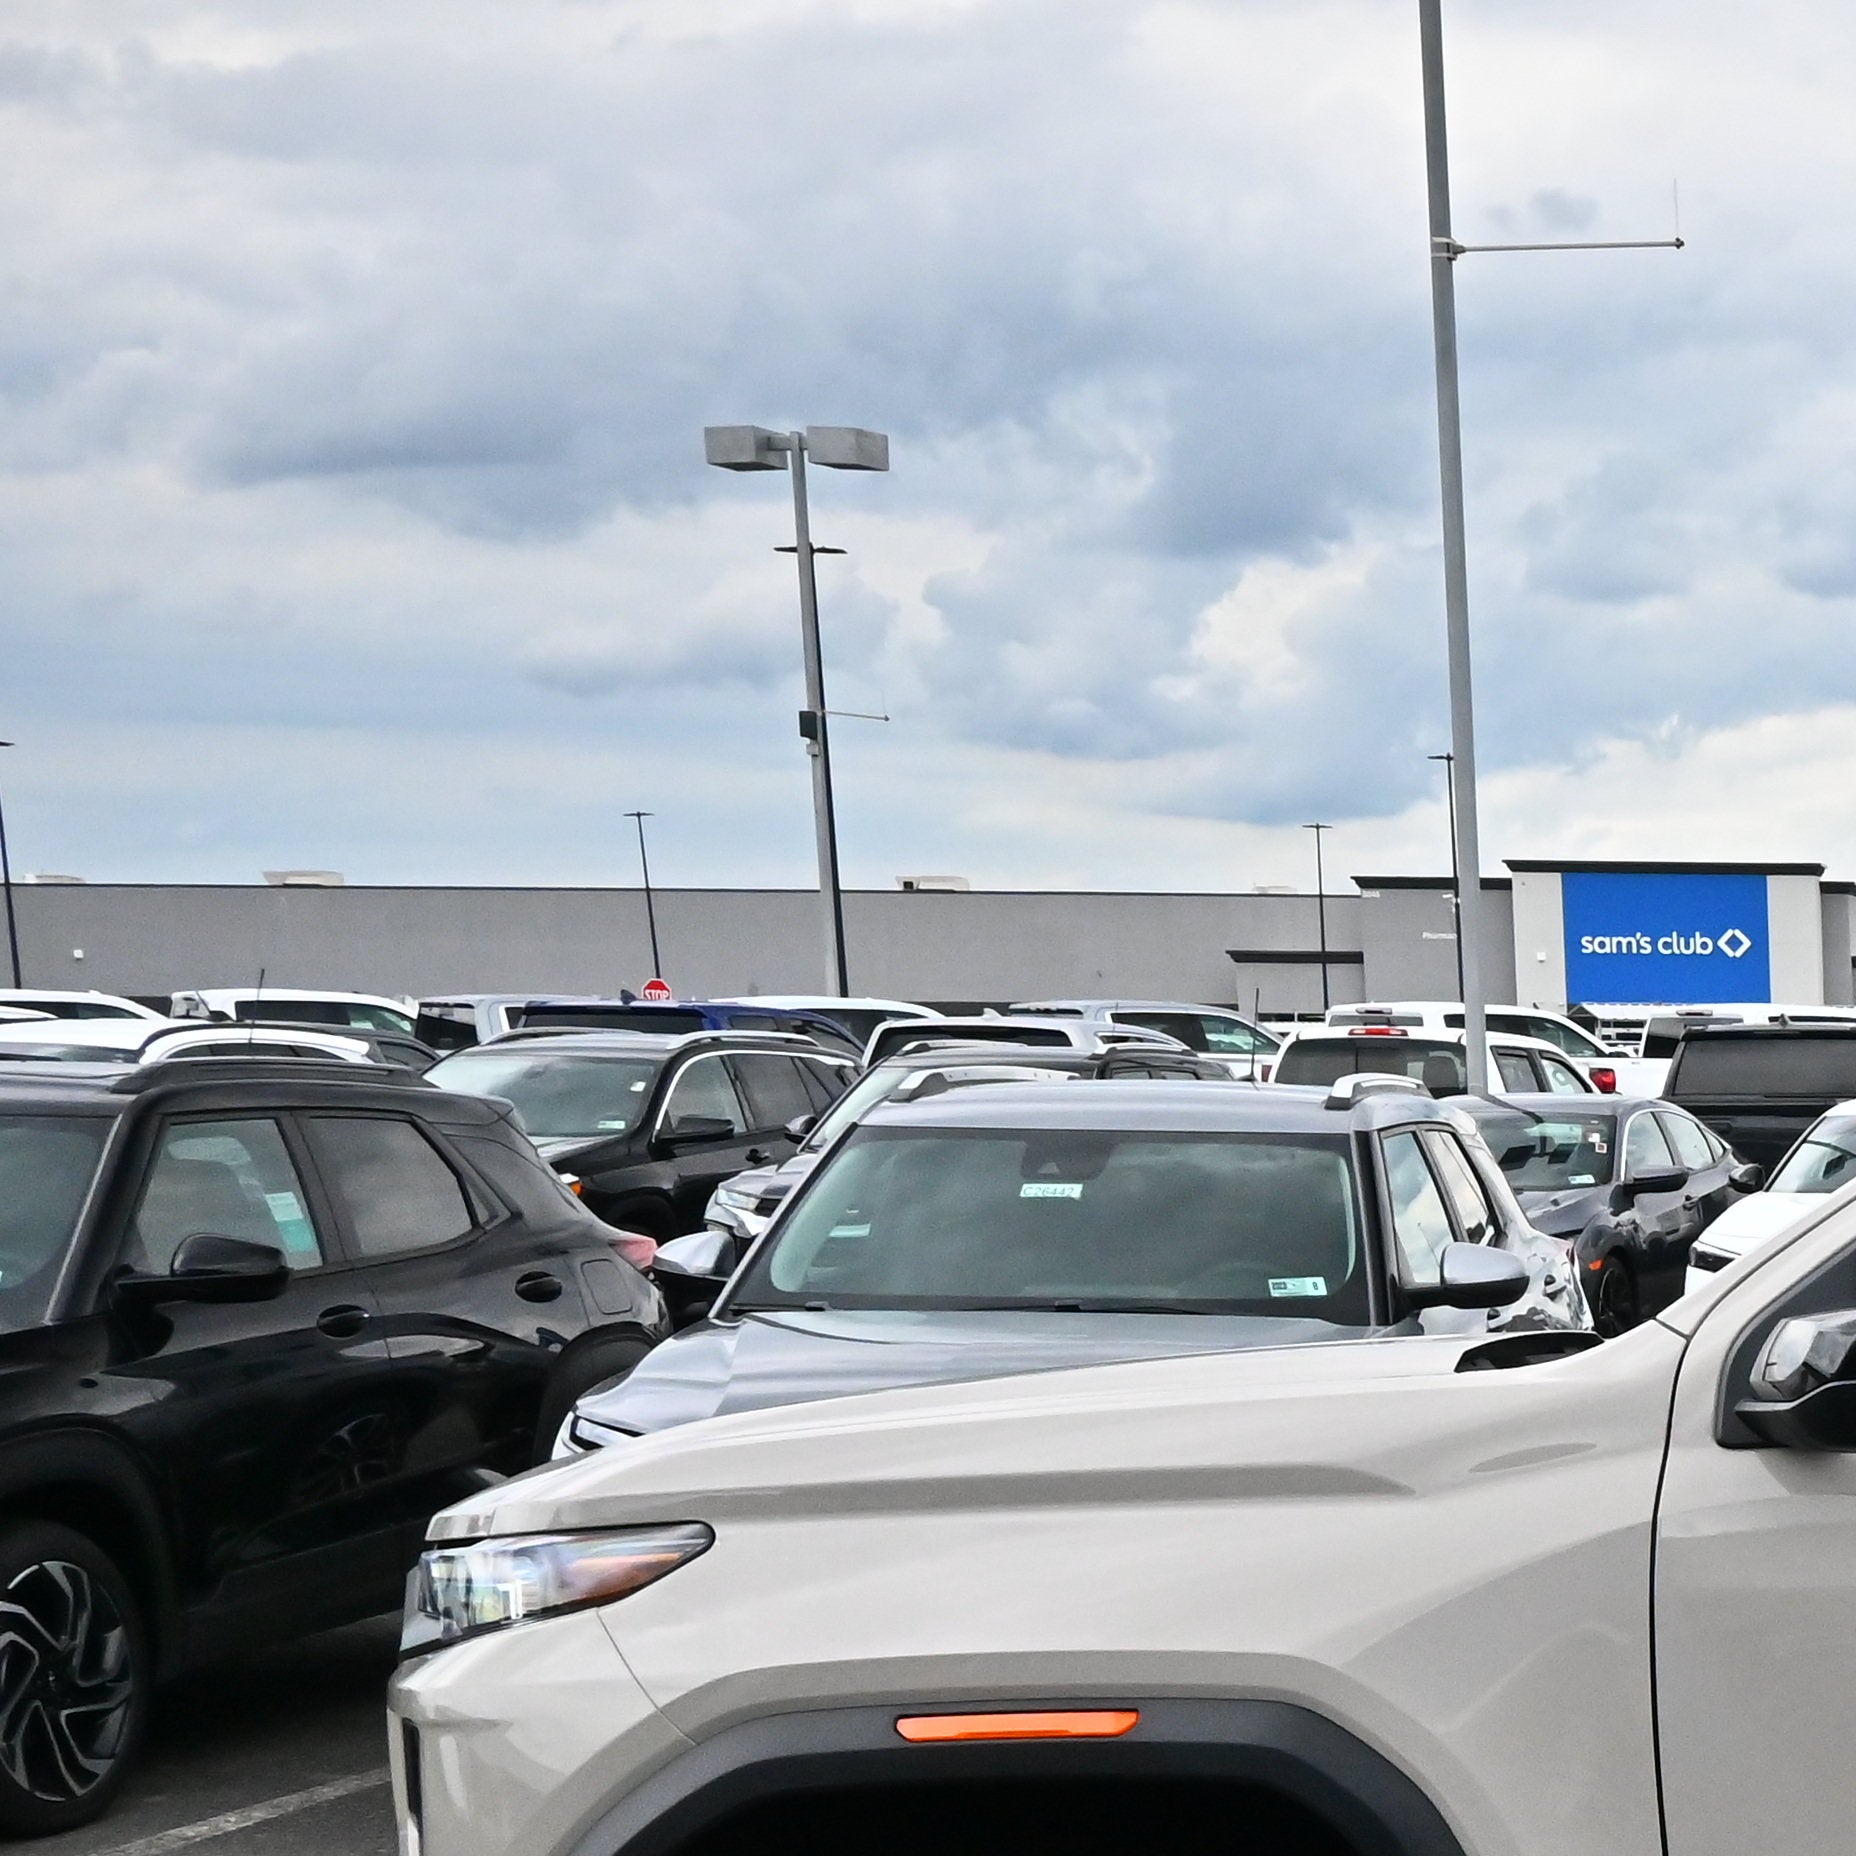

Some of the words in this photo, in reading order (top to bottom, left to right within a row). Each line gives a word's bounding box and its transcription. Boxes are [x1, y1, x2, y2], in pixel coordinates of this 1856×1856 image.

[1580, 932, 1652, 954] sam's
[1657, 931, 1713, 955] club
[644, 989, 669, 1000] STOP
